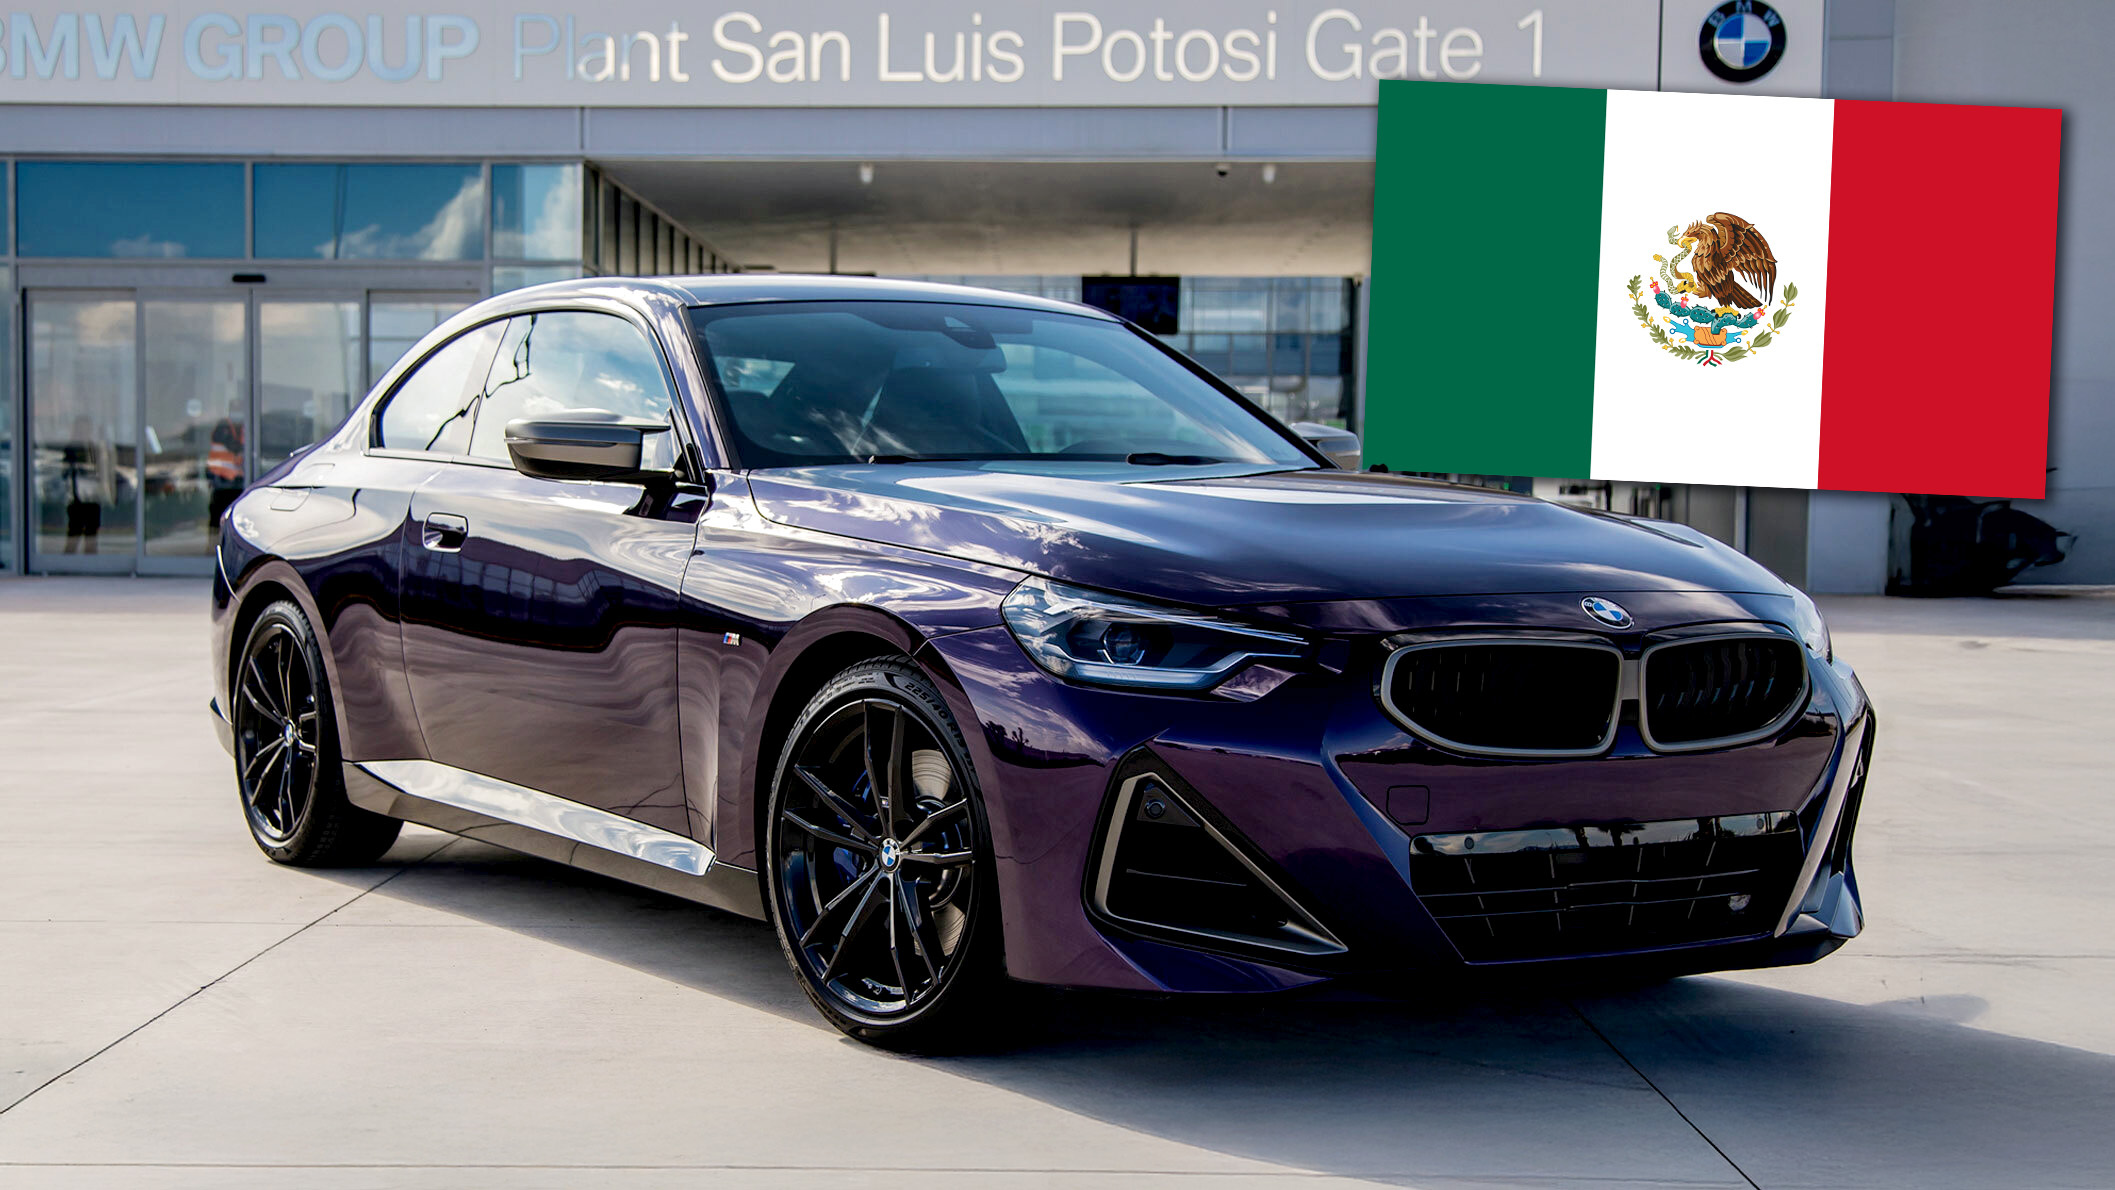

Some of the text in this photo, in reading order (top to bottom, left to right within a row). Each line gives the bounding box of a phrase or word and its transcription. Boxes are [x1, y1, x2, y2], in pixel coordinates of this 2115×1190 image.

[0, 8, 1545, 83] MW GROUP Plant San Luis Potosi Gate 1
[905, 682, 948, 719] 225/40
